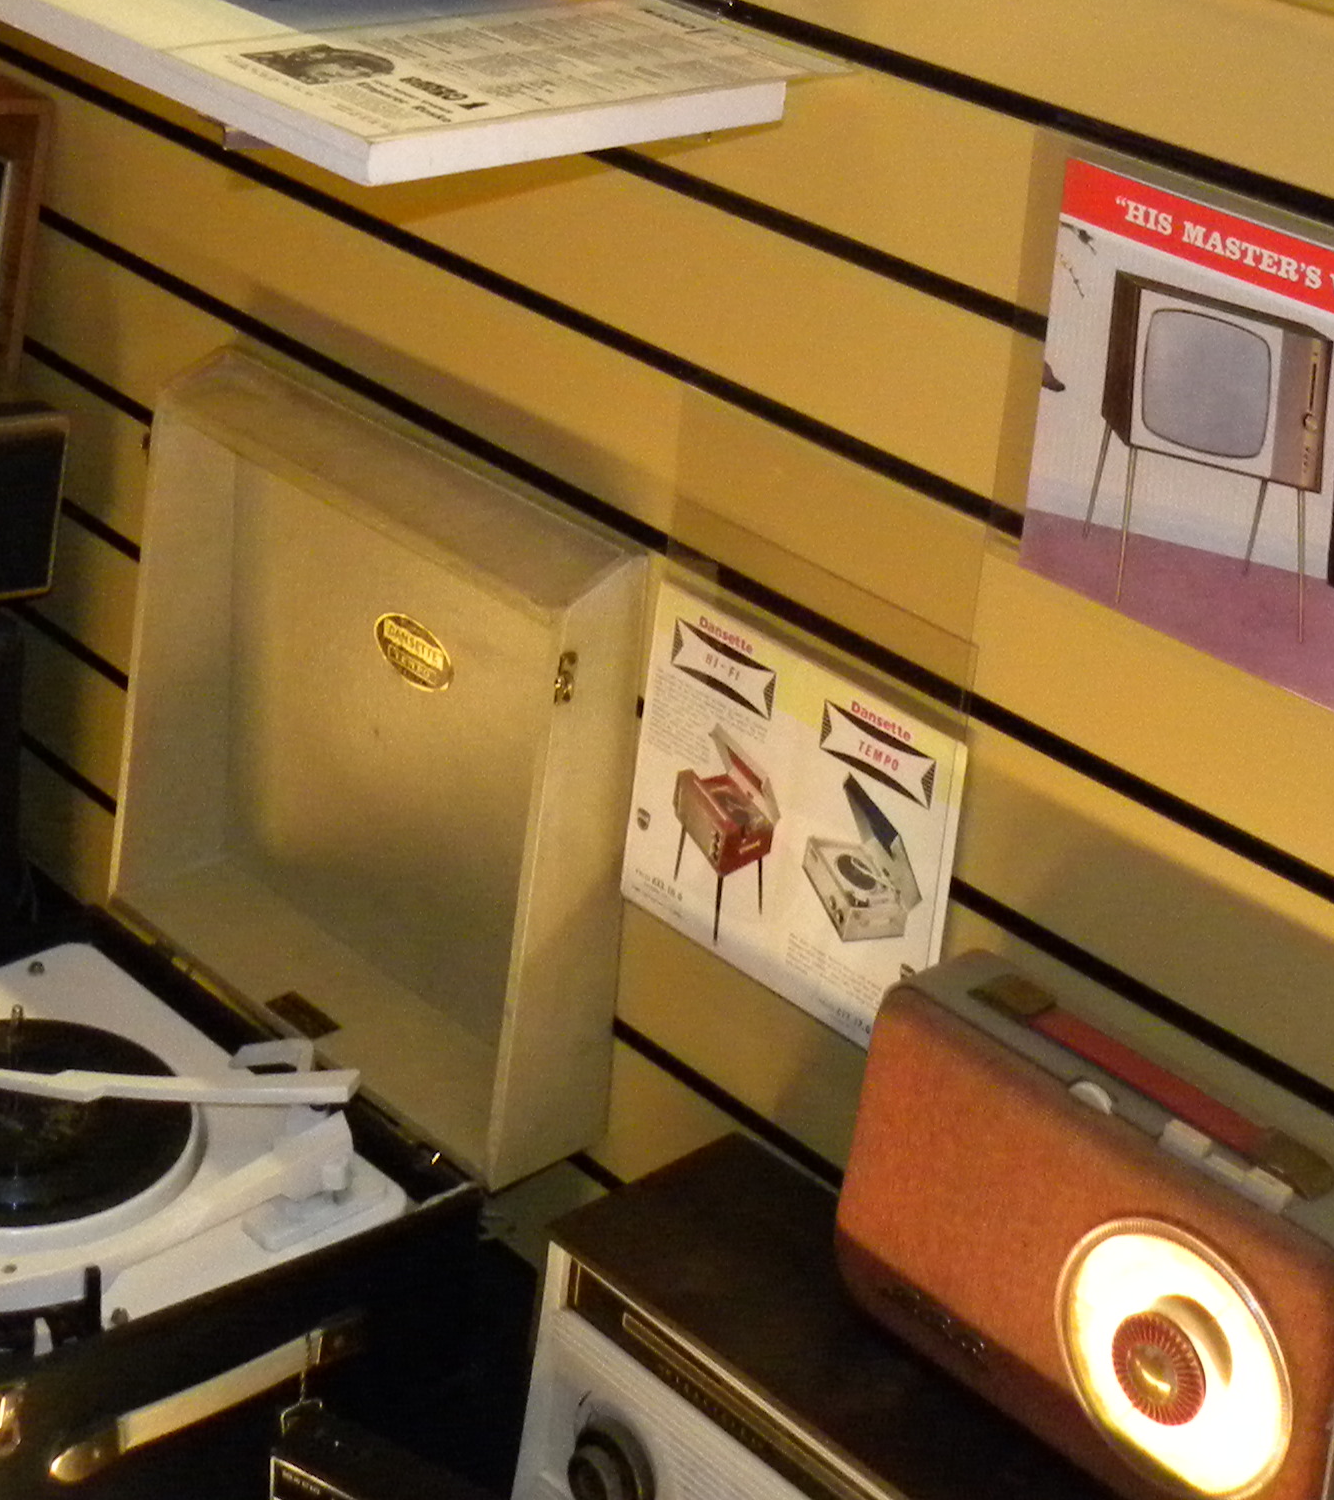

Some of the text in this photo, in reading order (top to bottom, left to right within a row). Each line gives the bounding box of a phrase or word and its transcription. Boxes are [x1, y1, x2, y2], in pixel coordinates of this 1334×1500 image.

[1115, 194, 1174, 236] “HIS
[1181, 220, 1323, 290] MASTER'S
[699, 615, 754, 655] Dansette
[704, 653, 741, 681] HI-FI
[850, 700, 912, 742] Dansette
[858, 739, 900, 772] TEMPO
